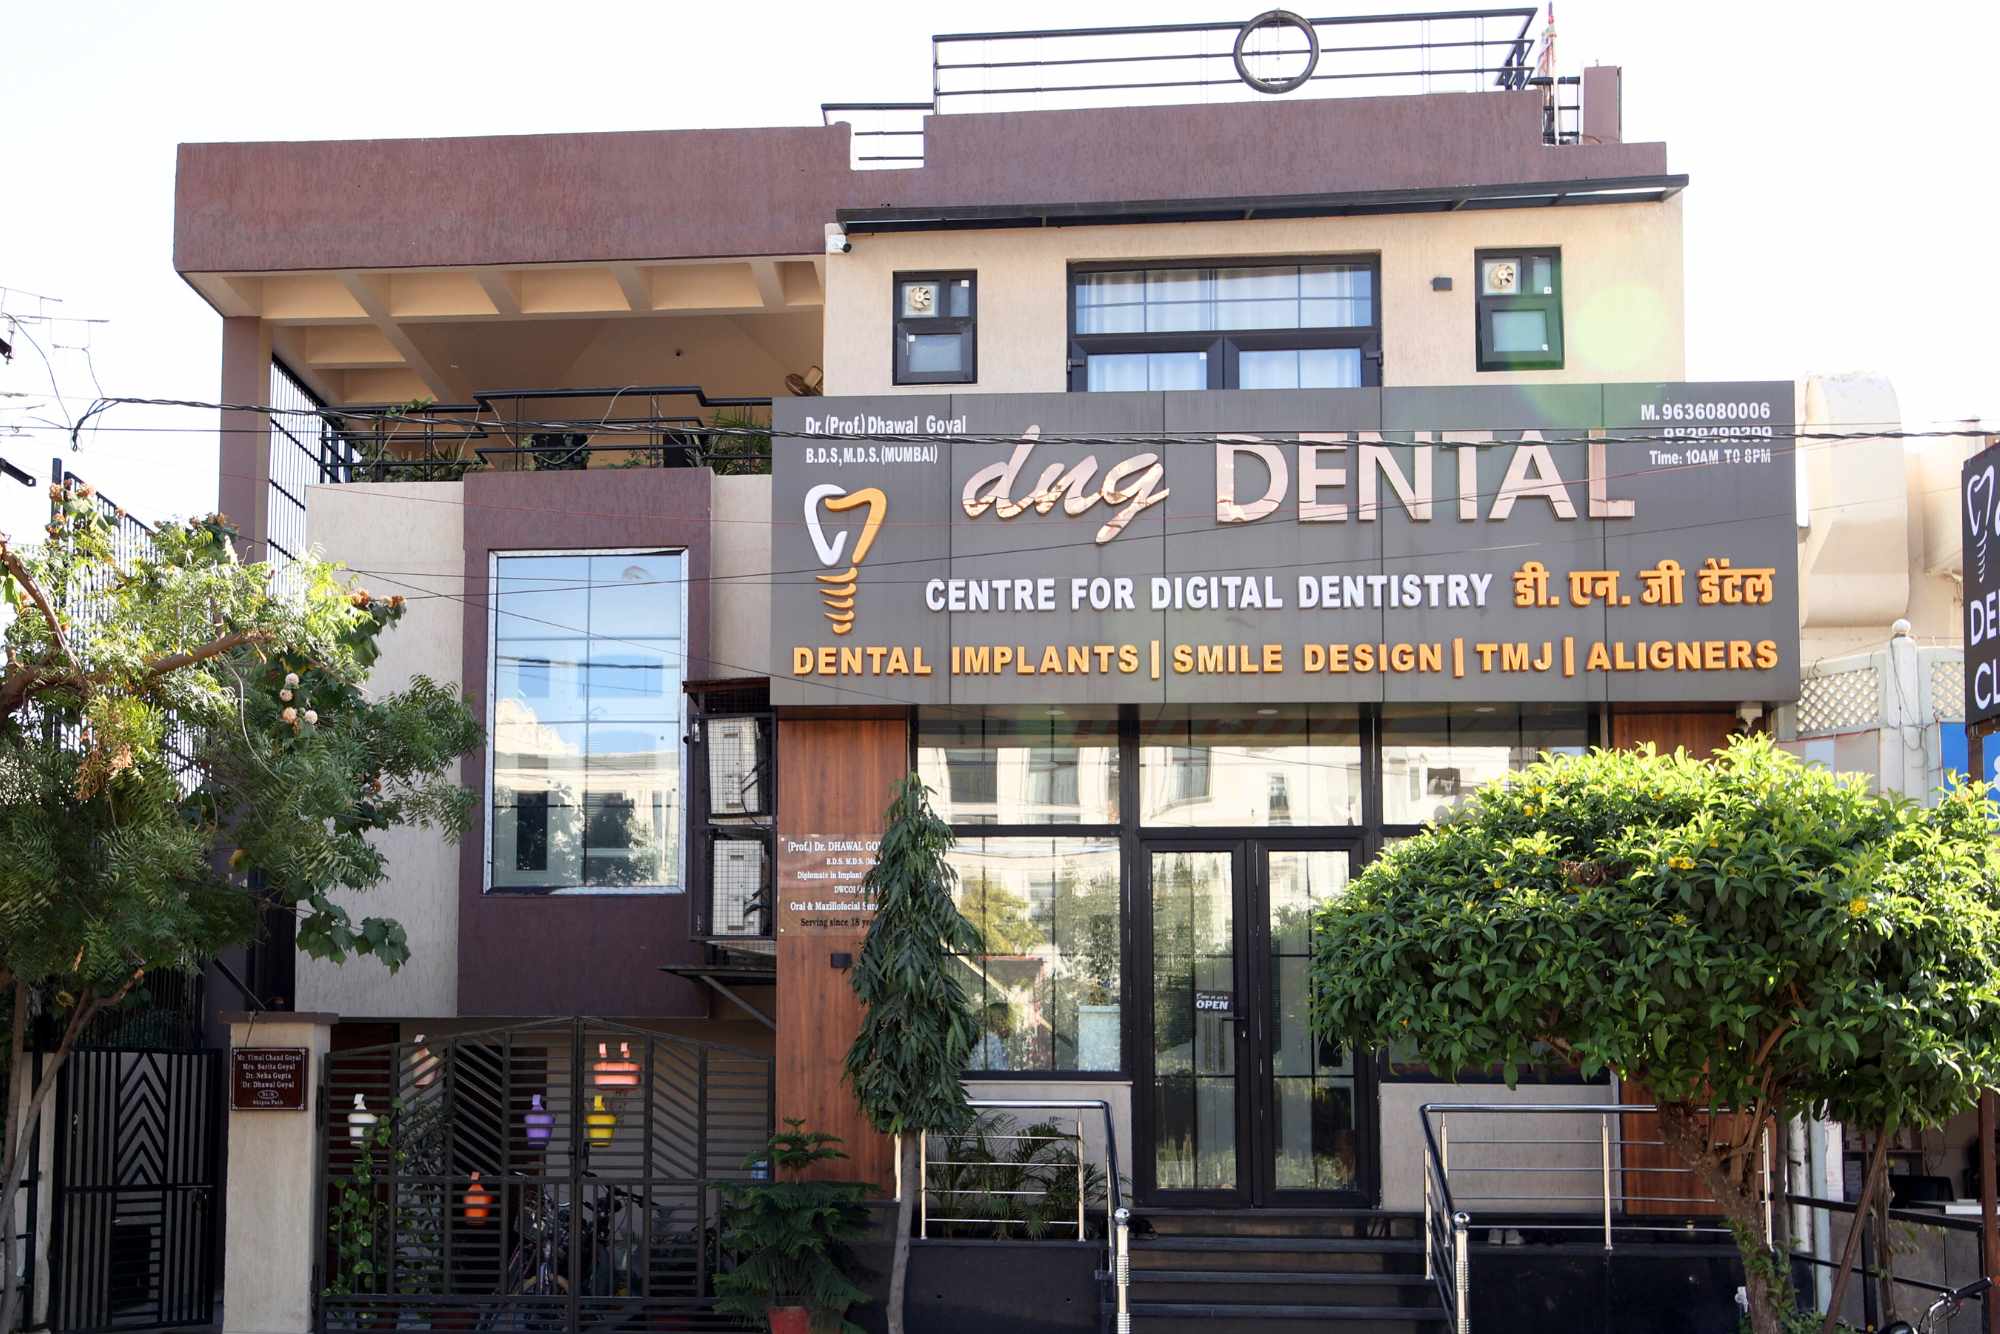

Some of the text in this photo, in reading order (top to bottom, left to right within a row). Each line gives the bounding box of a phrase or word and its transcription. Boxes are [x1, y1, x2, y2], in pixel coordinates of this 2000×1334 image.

[1662, 402, 1770, 420] 9636080006
[868, 416, 918, 434] Dhawal
[926, 415, 966, 439] Goyal
[1649, 450, 1682, 465] Time:
[1686, 449, 1719, 464] 10AM
[1745, 448, 1771, 463] 8PM
[962, 424, 1636, 544] dng DENTAL
[1513, 558, 1776, 608] डी. एन. जी डेंटल
[925, 573, 1494, 612] CENTRE FOR DIGITAL DENTISTRY
[793, 640, 1778, 675] DENTAL IMPLANTS SMILE DESIGN TMJ ALIGNERS
[815, 842, 826, 851] Dr.
[828, 842, 863, 851] DHAWAL
[790, 901, 806, 911] Oral
[807, 903, 813, 911] &
[815, 901, 860, 911] Maxillofacial
[801, 919, 827, 928] Serving
[1196, 1000, 1229, 1010] OPEN
